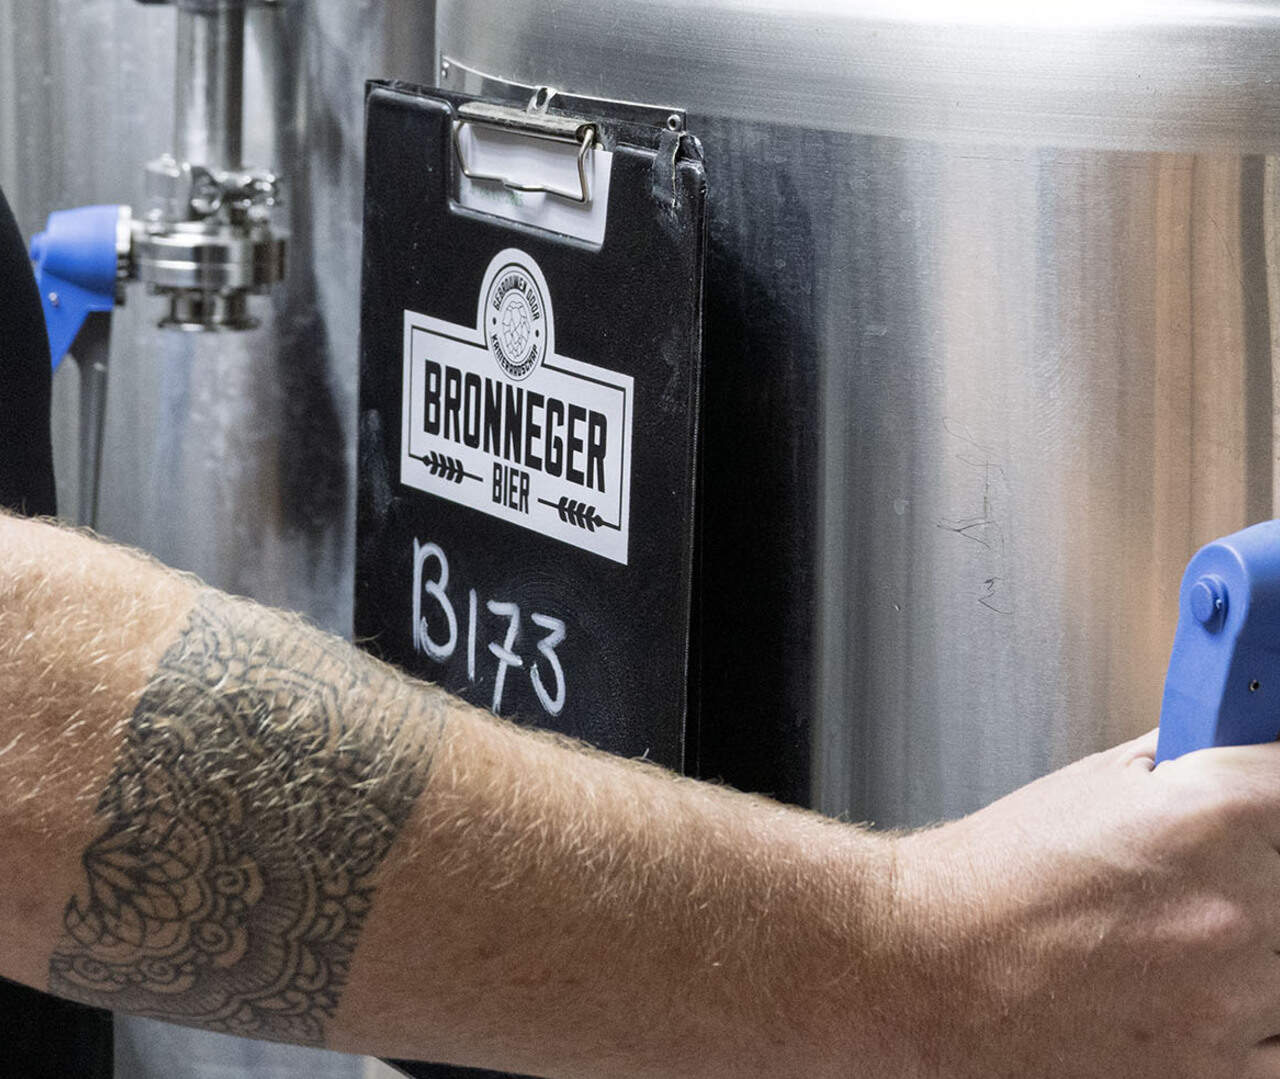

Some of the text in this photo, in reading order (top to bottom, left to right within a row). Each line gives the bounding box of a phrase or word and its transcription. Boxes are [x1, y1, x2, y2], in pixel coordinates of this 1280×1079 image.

[423, 360, 607, 494] BRONNEGER
[491, 462, 530, 515] BIER
[412, 536, 566, 717] B173
